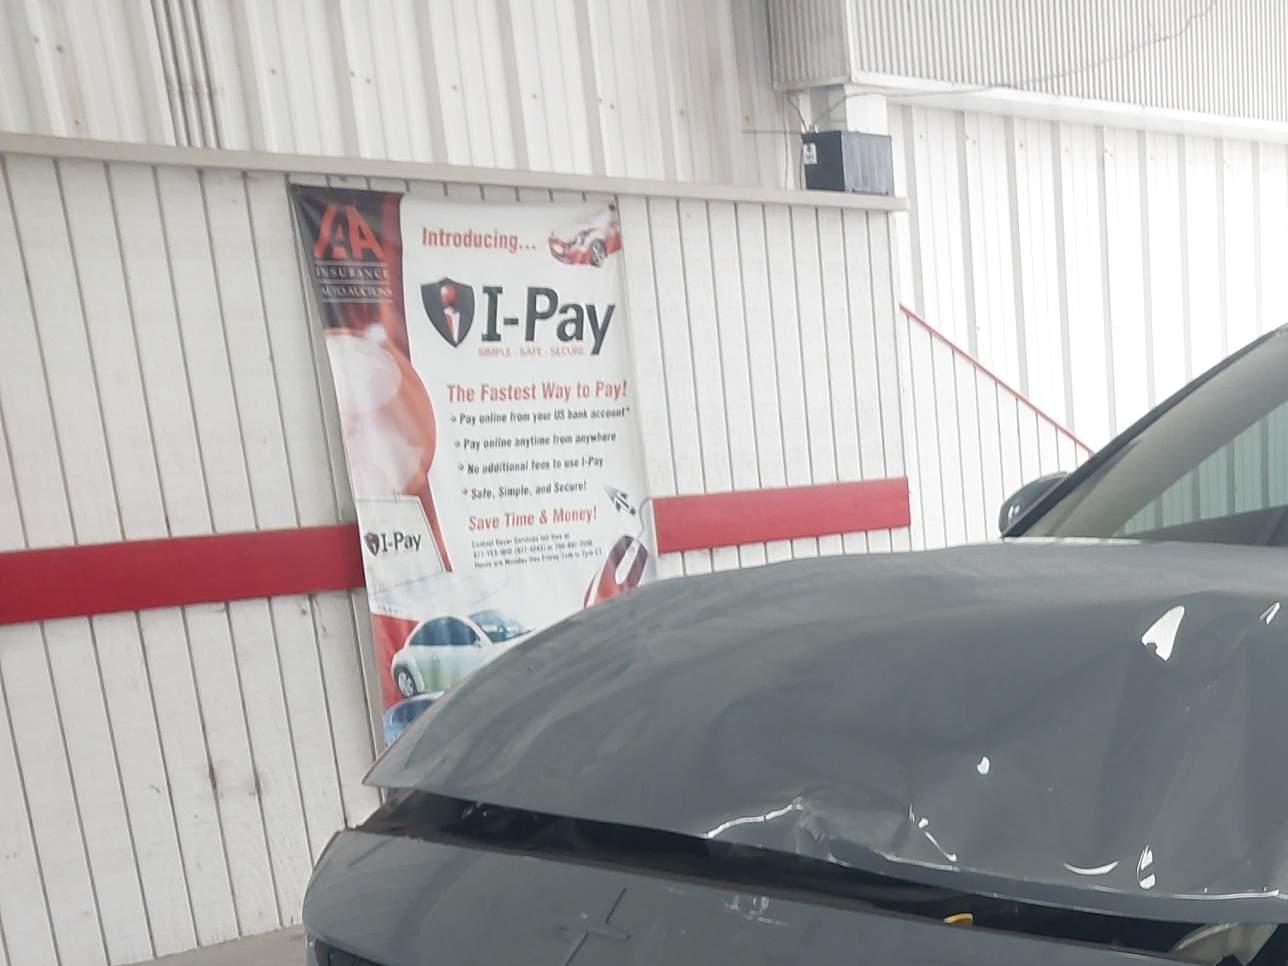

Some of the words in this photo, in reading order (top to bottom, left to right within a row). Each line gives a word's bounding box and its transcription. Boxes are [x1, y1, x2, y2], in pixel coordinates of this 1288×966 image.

[421, 227, 536, 253] Introducing...
[480, 285, 616, 356] I-Pay
[478, 347, 511, 357] SIMPLE
[519, 347, 543, 356] SAFE
[550, 346, 584, 355] SECURE
[447, 384, 475, 401] The
[480, 383, 536, 401] Fastest
[541, 382, 571, 400] Way
[576, 382, 590, 397] to
[595, 380, 628, 399] Pay!
[459, 413, 476, 426] Pay
[479, 413, 507, 424] online
[510, 412, 530, 421] from
[533, 413, 551, 424] your
[554, 410, 566, 420] US
[567, 409, 588, 419] bank
[463, 438, 480, 450] Pay
[483, 437, 512, 449] online
[514, 436, 550, 449] anytime
[553, 434, 573, 444] from
[575, 432, 616, 444] anywhere
[467, 464, 480, 475] No
[482, 460, 529, 474] additional
[531, 460, 550, 470] fees
[553, 459, 562, 469] to
[564, 459, 579, 468] use
[581, 456, 604, 468] I-Pay
[471, 487, 495, 500] Safe,
[498, 485, 532, 498] Simple,
[535, 484, 552, 494] and
[554, 481, 587, 492] Secure!
[469, 515, 500, 531] Save
[505, 512, 535, 527] Time
[539, 509, 548, 525] &
[553, 505, 598, 523] Money!
[381, 531, 421, 552] I-Pay
